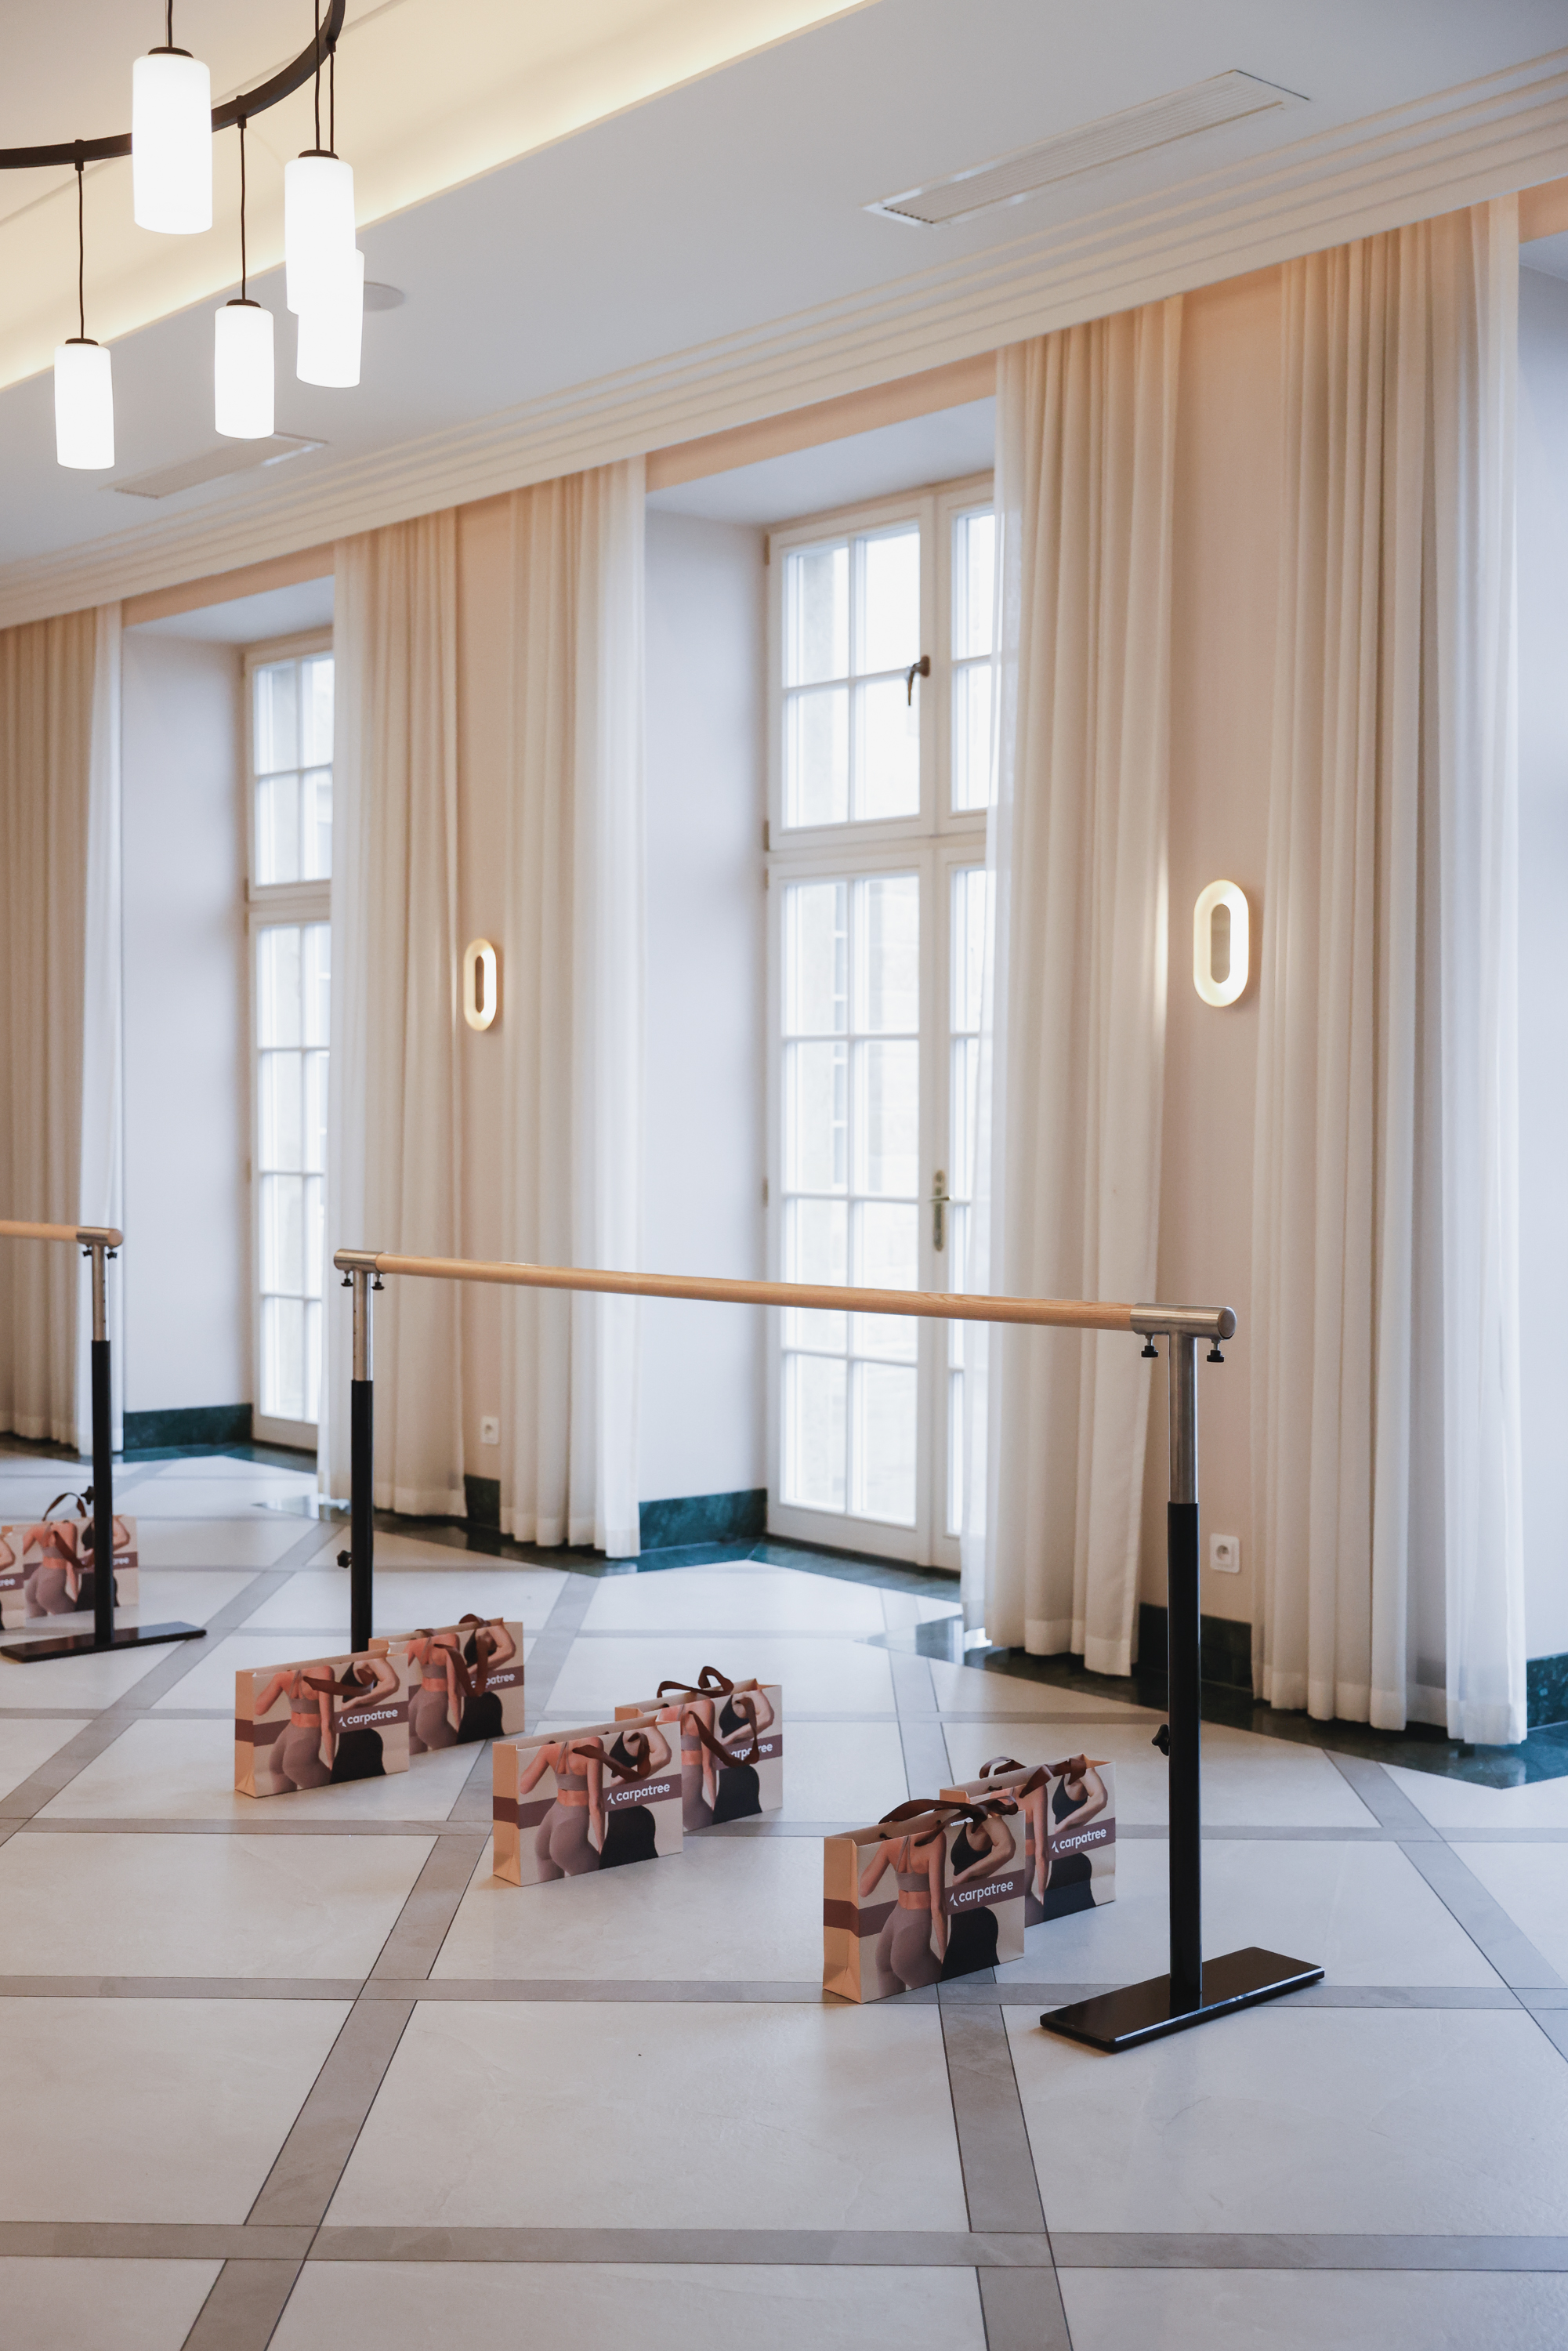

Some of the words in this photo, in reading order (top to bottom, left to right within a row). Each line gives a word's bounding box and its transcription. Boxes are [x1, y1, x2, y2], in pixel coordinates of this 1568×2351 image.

[347, 1709, 398, 1725] carpatree
[616, 1784, 670, 1802] carpatree
[1059, 1828, 1106, 1849] carpatree
[958, 1881, 1013, 1902] carpatree
